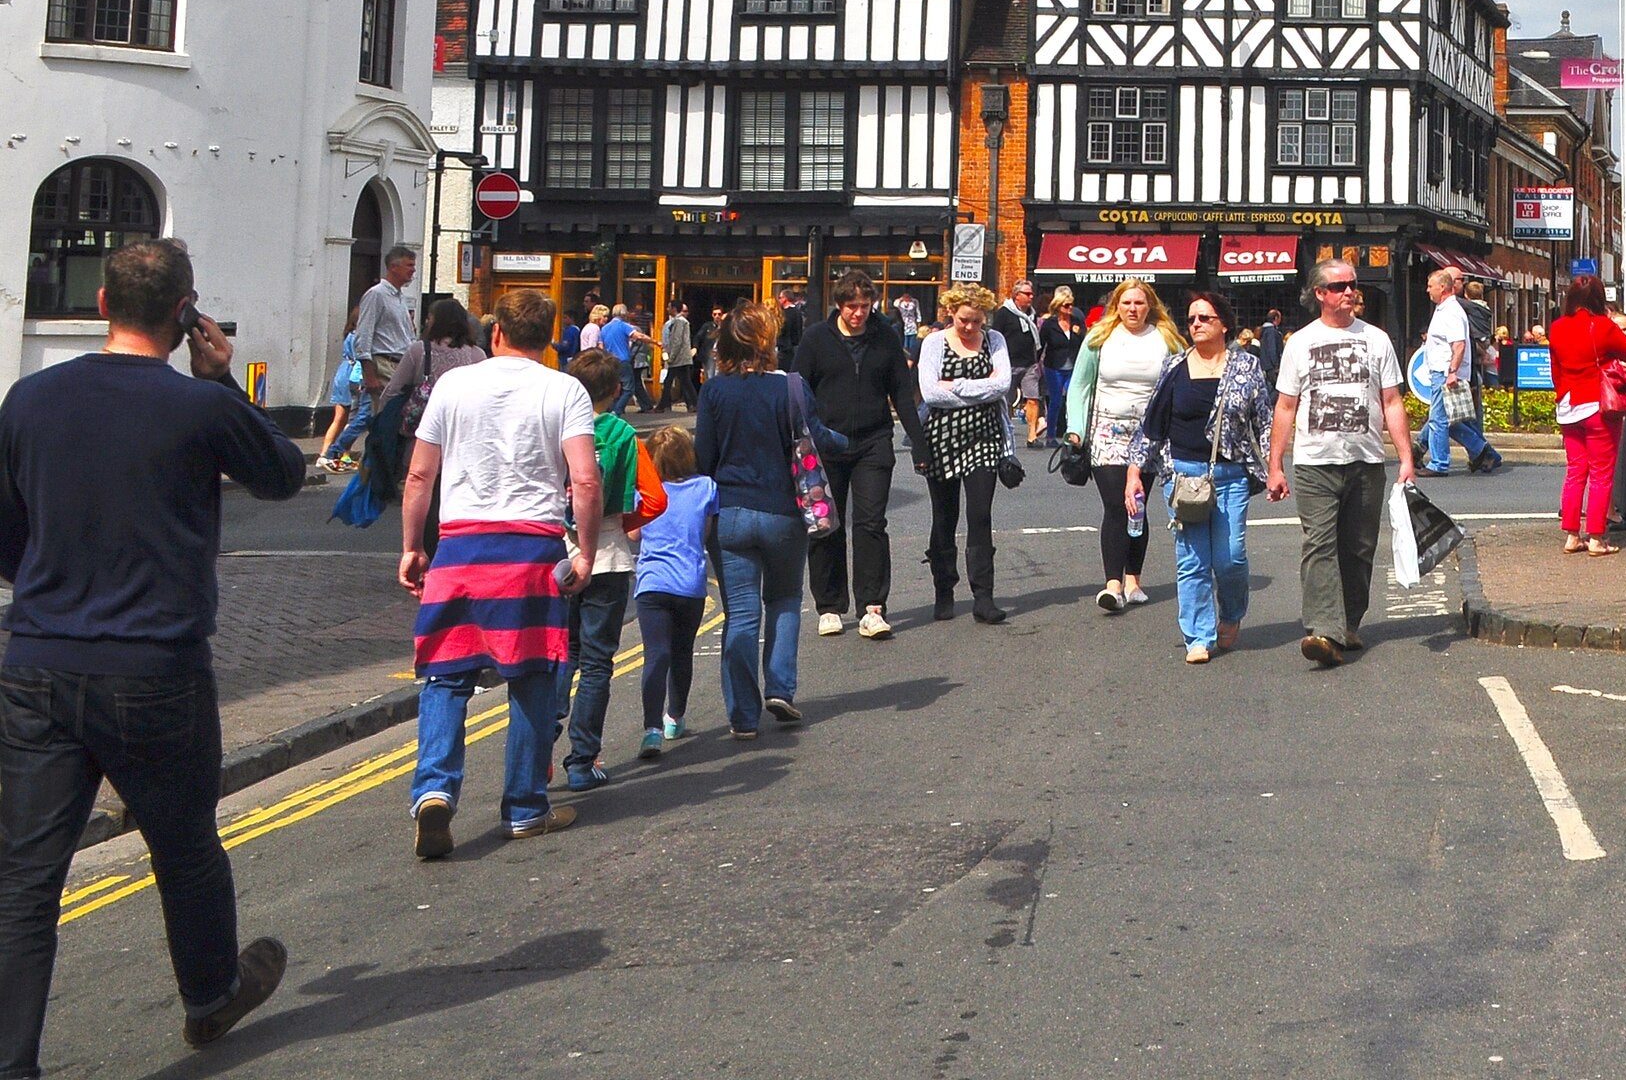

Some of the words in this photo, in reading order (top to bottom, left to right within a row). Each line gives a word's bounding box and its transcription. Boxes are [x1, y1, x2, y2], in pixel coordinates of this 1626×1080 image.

[1568, 65, 1589, 75] The
[1589, 62, 1621, 75] Crof
[1522, 203, 1534, 211] TO
[671, 210, 708, 224] WHITE
[1099, 209, 1149, 224] COSTA
[1154, 212, 1198, 222] CAPPUCCINO
[1225, 212, 1245, 222] LATTE
[1251, 212, 1286, 223] ESPRESSO
[1291, 212, 1343, 226] COSTA
[1068, 245, 1168, 266] COSTA
[1223, 250, 1292, 265] COSTA
[955, 271, 978, 279] ENDS
[1075, 273, 1089, 283] WE
[1089, 273, 1114, 283] MAKE
[1115, 273, 1124, 283] IT
